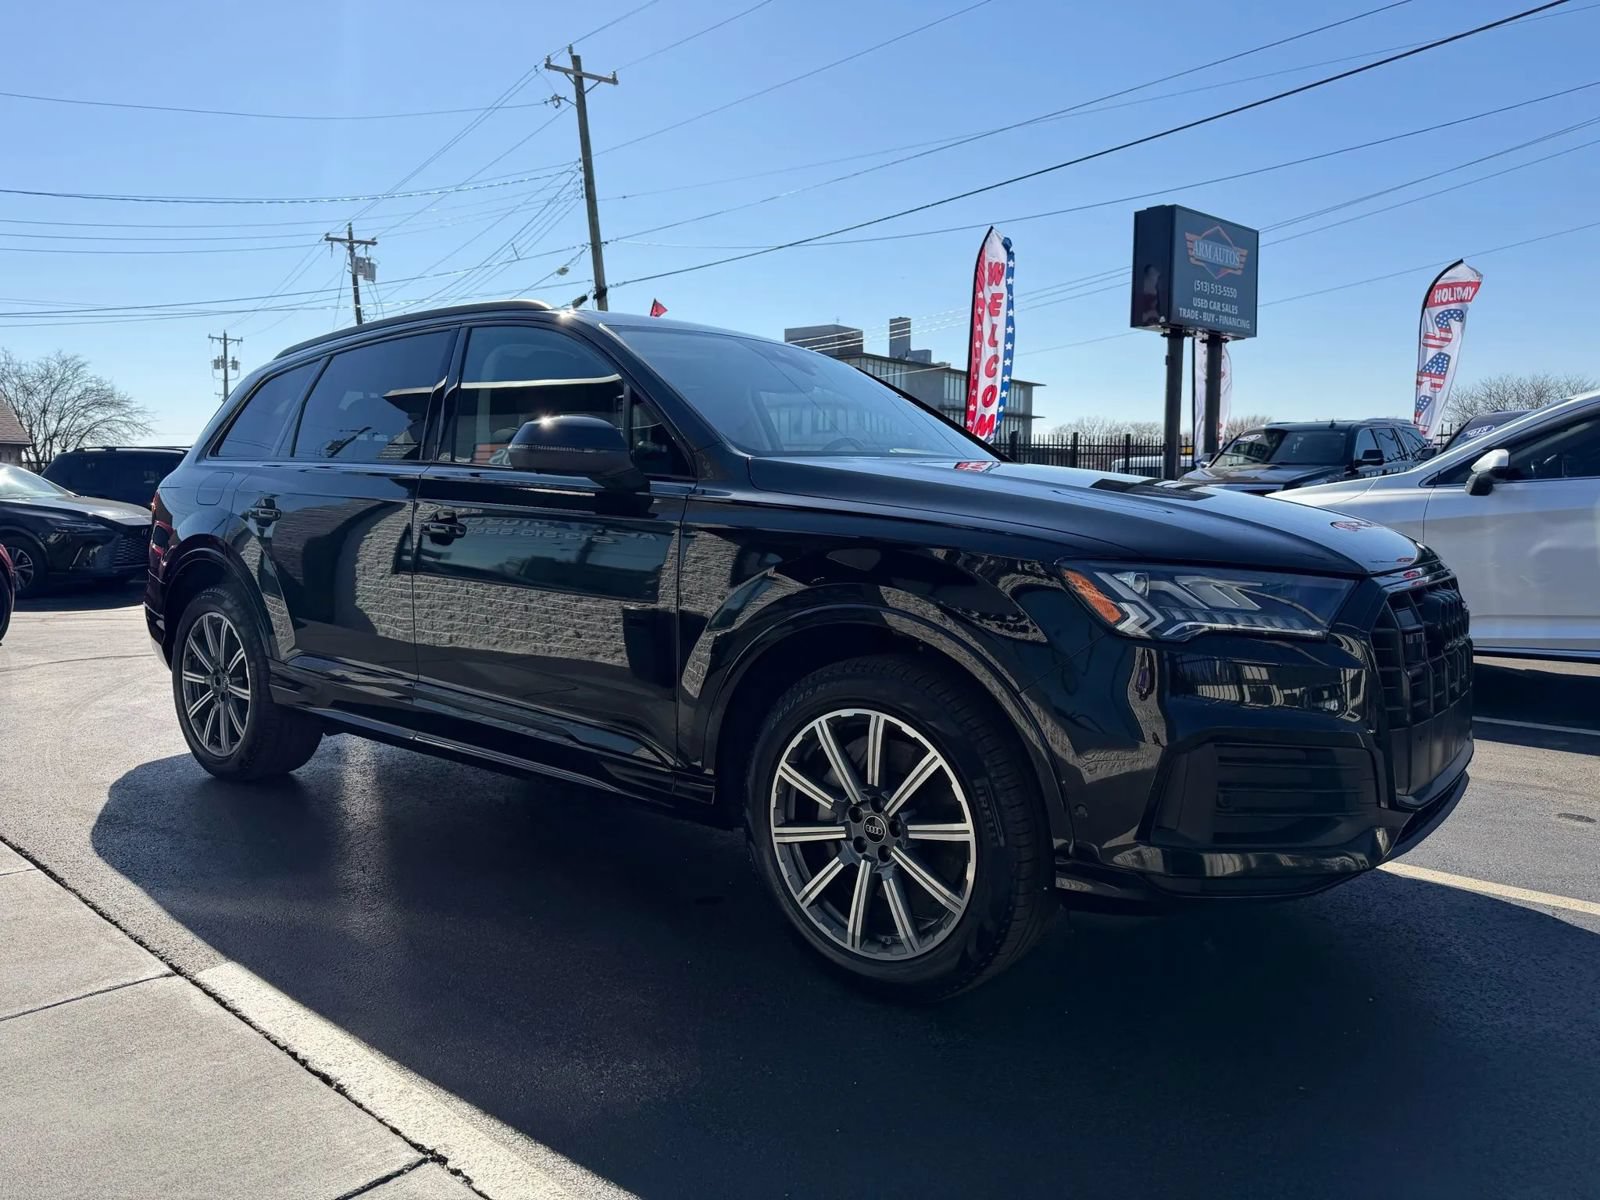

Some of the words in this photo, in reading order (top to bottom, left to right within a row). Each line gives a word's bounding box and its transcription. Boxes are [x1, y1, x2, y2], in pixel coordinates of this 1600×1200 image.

[1214, 247, 1240, 266] AUTOS
[1194, 279, 1210, 294] (513)
[1211, 283, 1238, 299] 513-5550
[1434, 286, 1475, 304] HOLIDAY
[1192, 297, 1208, 309] USED
[1209, 300, 1221, 312] CAR
[1221, 303, 1238, 315] SALES
[1179, 307, 1199, 320] TRADE
[1202, 312, 1216, 323] BUY
[1218, 315, 1251, 330] FINANCING
[1415, 309, 1465, 447] SAL
